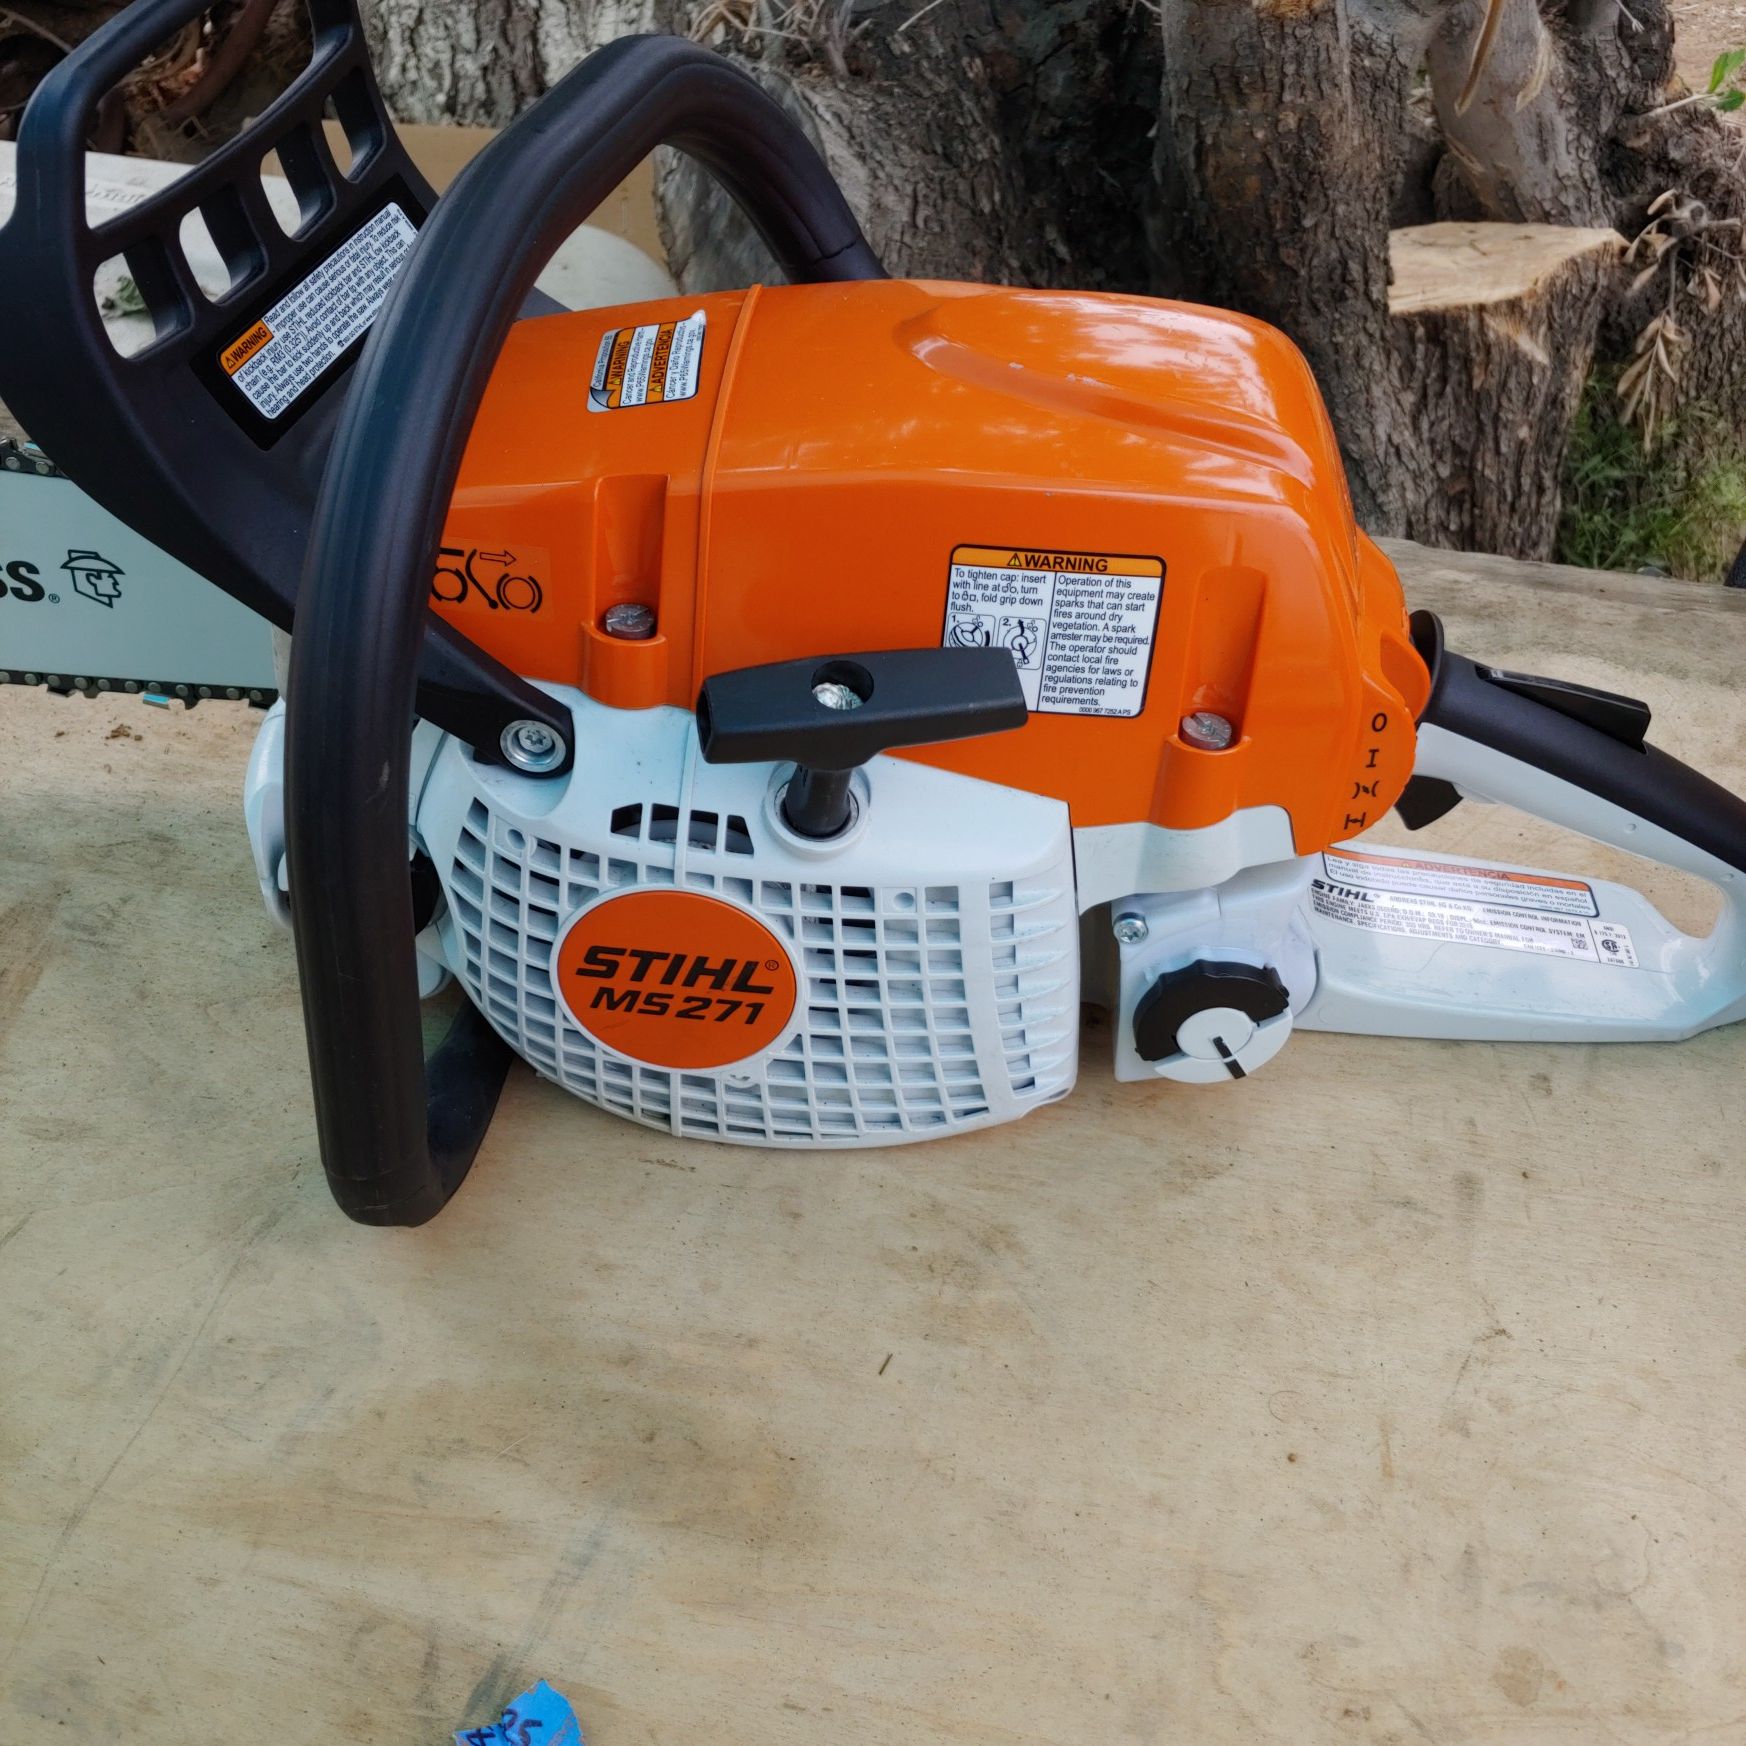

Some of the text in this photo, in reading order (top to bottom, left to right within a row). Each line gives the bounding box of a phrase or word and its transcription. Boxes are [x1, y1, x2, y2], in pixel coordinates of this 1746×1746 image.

[389, 213, 401, 225] risk
[375, 220, 393, 238] reduce
[369, 232, 379, 243] To
[394, 238, 405, 250] can
[347, 249, 362, 263] fatal
[384, 244, 397, 258] This
[262, 307, 281, 326] Read
[276, 298, 291, 313] and
[286, 286, 305, 304] follow
[300, 280, 311, 291] all
[307, 268, 327, 287] safety
[321, 245, 352, 274] precautions
[346, 241, 355, 250] in
[351, 222, 376, 246] instruction
[372, 208, 392, 227] manual
[344, 259, 352, 268] or
[387, 251, 405, 270] serious
[327, 263, 347, 283] serious
[363, 267, 376, 281] any
[382, 265, 391, 274] in
[353, 273, 366, 287] with
[371, 270, 385, 285] result
[314, 279, 331, 295] cause
[338, 288, 351, 301] bar
[347, 282, 358, 294] tip
[362, 281, 376, 296] may
[235, 371, 246, 382] of
[241, 351, 268, 377] kickback
[264, 338, 283, 358] injury
[279, 331, 291, 343] use
[287, 314, 307, 334] STIHL
[303, 297, 326, 320] reduced
[322, 279, 346, 302] kickback
[341, 272, 353, 285] bar
[349, 264, 362, 277] and
[358, 251, 376, 269] STIHL
[372, 244, 383, 256] low
[379, 228, 401, 249] kickback
[304, 292, 316, 304] can
[334, 295, 343, 305] of
[348, 290, 365, 307] which
[295, 300, 308, 312] use
[317, 300, 338, 321] contact
[337, 302, 352, 317] back
[272, 307, 300, 333] improper
[303, 316, 321, 334] Avoid
[327, 313, 341, 326] and
[272, 371, 296, 396] Always
[292, 364, 304, 377] use
[301, 354, 314, 367] two
[309, 339, 329, 359] hands
[325, 334, 334, 344] to
[330, 318, 352, 340] operate
[347, 310, 358, 323] the
[364, 285, 385, 307] Always
[381, 276, 395, 291] wear
[322, 323, 333, 334] up
[229, 325, 268, 362] WARNING
[299, 327, 326, 355] suddenly
[289, 348, 304, 362] kick
[610, 340, 629, 378] WARNING
[651, 329, 671, 384] ADVERTENCIA
[275, 362, 288, 376] bar
[284, 358, 294, 368] to
[243, 372, 261, 391] chain
[266, 371, 279, 385] the
[251, 381, 270, 400] cause
[265, 393, 290, 418] hearing
[285, 383, 299, 398] and
[294, 371, 312, 388] head
[1023, 554, 1108, 572] WARNING
[954, 567, 1046, 583] To tighten cap: insert
[1057, 574, 1132, 588] Operation of this
[952, 579, 1038, 594] with line at turn
[1055, 586, 1155, 601] equipment may create
[951, 591, 1043, 606] to fold grip down
[1054, 597, 1145, 611] sparks that can start
[949, 601, 974, 612] flush.
[1053, 608, 1123, 623] fires around dry
[1051, 619, 1136, 635] vegetation. A spark
[1050, 630, 1150, 647] arrester may be required.
[1048, 640, 1137, 655] The operator should
[1047, 652, 1119, 664] contact local fire
[1045, 662, 1134, 676] agencies for laws or
[1044, 673, 1139, 688] regulations relating to
[1042, 683, 1105, 697] fire prevention
[1041, 694, 1101, 707] requirements.
[1416, 861, 1509, 881] ADVERTENCIA
[1312, 879, 1374, 902] STIHL
[576, 945, 775, 995] STIHL
[590, 987, 765, 1025] MS 271
